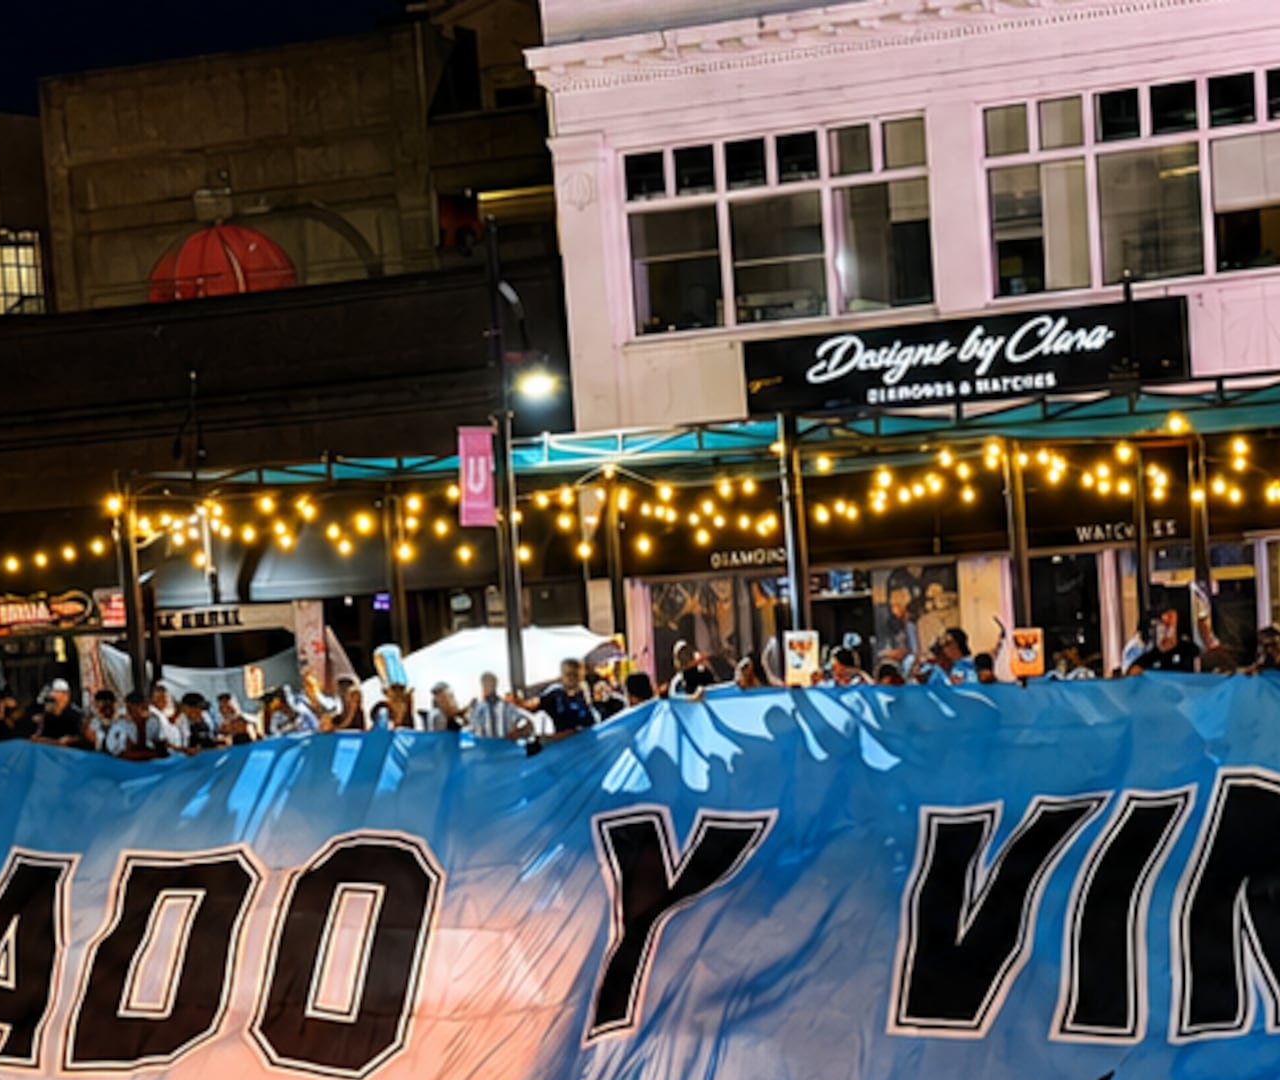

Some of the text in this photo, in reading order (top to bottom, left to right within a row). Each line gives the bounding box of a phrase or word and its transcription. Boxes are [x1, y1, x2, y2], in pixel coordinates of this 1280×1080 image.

[957, 324, 1008, 376] by
[466, 456, 487, 494] U
[583, 805, 780, 1048] Y
